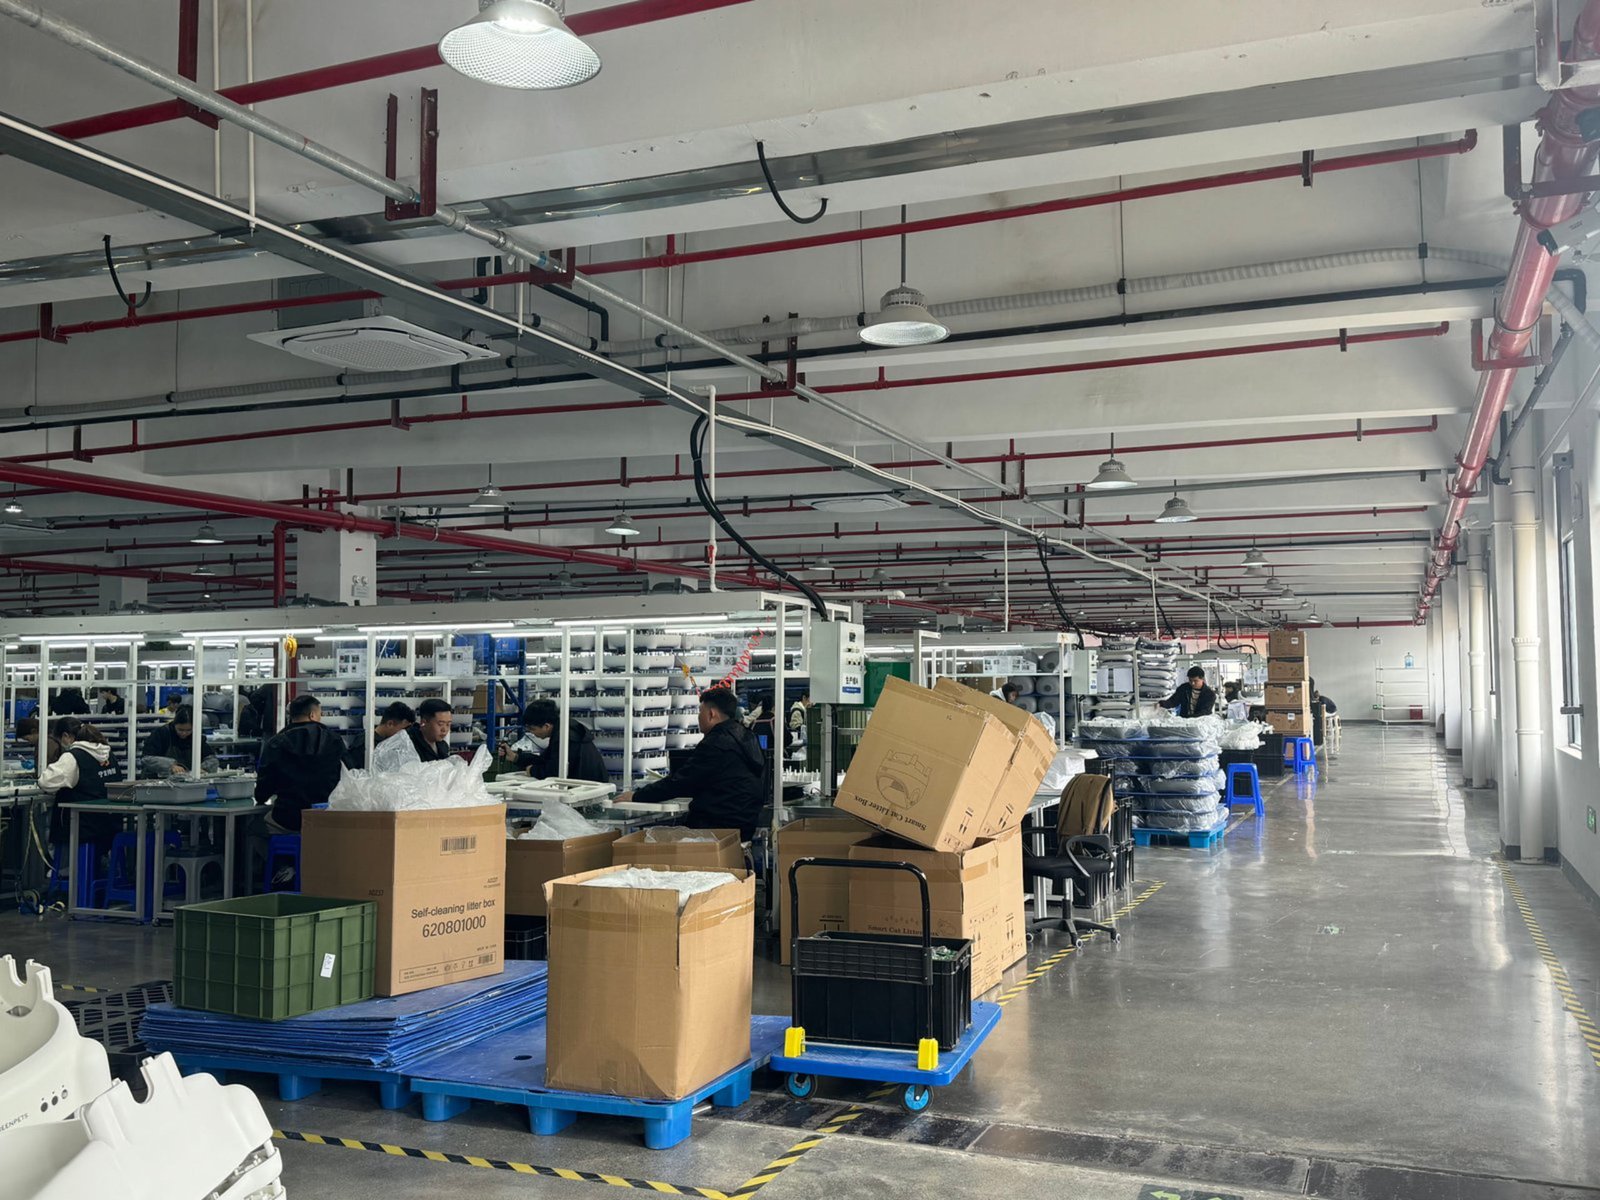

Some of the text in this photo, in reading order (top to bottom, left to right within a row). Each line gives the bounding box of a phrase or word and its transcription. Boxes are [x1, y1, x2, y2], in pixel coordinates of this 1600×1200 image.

[854, 795, 927, 831] Smart Cat Litter Box
[411, 899, 496, 918] Self-cleaning litter box
[422, 914, 486, 938] 620801000
